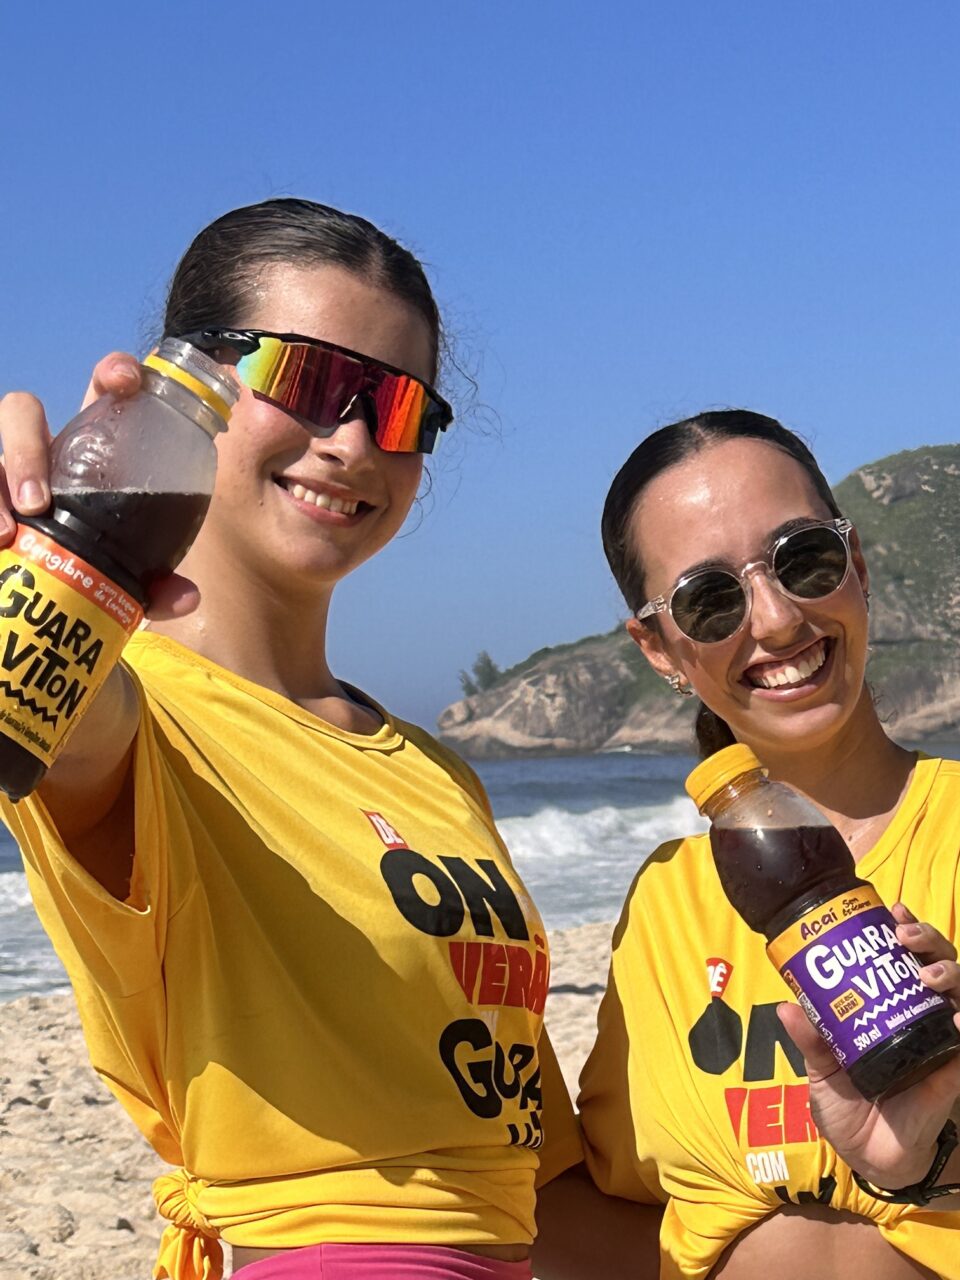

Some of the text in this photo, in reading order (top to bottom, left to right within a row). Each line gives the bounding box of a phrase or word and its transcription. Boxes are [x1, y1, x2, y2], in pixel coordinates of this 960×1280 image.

[0, 564, 104, 676] GUARA
[380, 848, 529, 942] ON
[448, 933, 549, 1016] VERÃ
[805, 923, 902, 990] GUARA
[745, 1150, 790, 1184] COM
